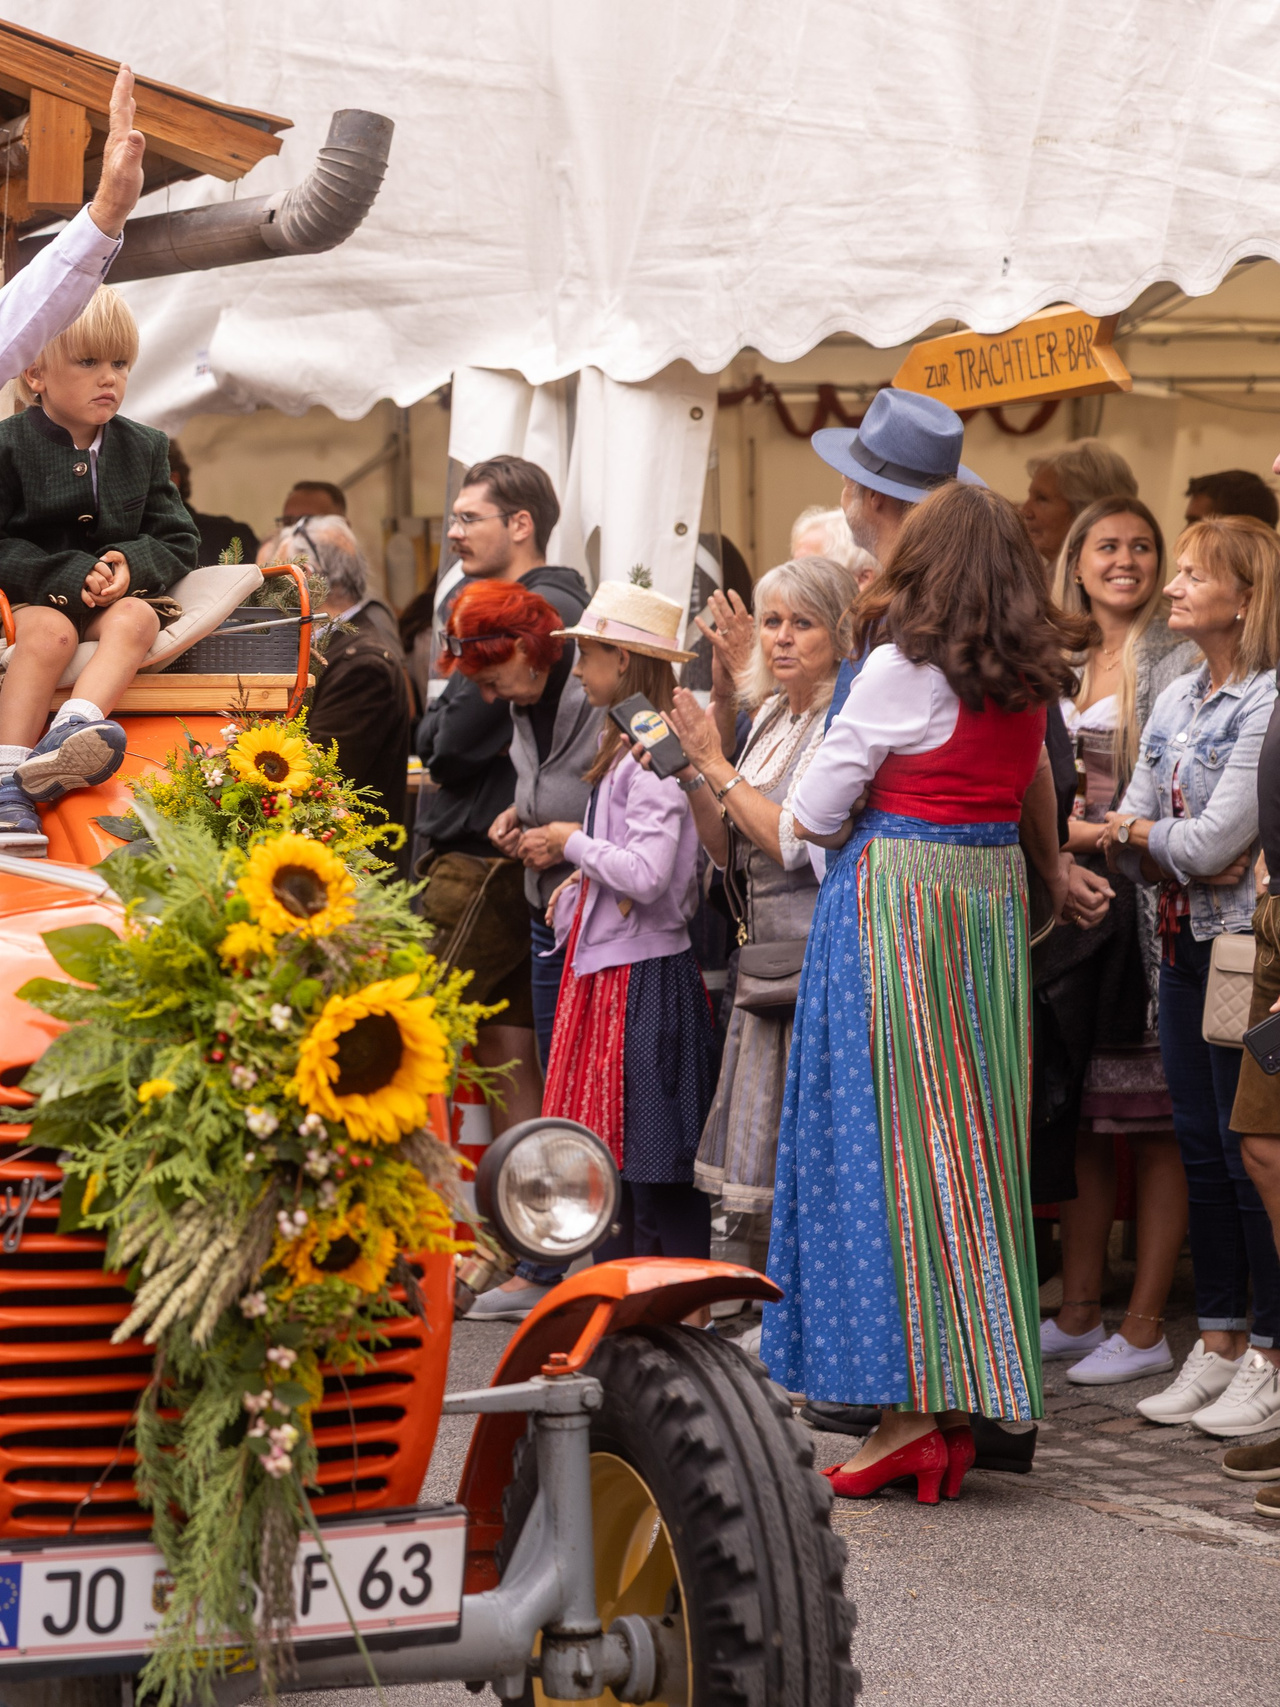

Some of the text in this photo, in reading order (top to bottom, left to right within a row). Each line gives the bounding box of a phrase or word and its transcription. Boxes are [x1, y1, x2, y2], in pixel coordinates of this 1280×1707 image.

[924, 363, 952, 389] ZUR
[42, 1567, 125, 1636] JO
[358, 1541, 434, 1611] 63
